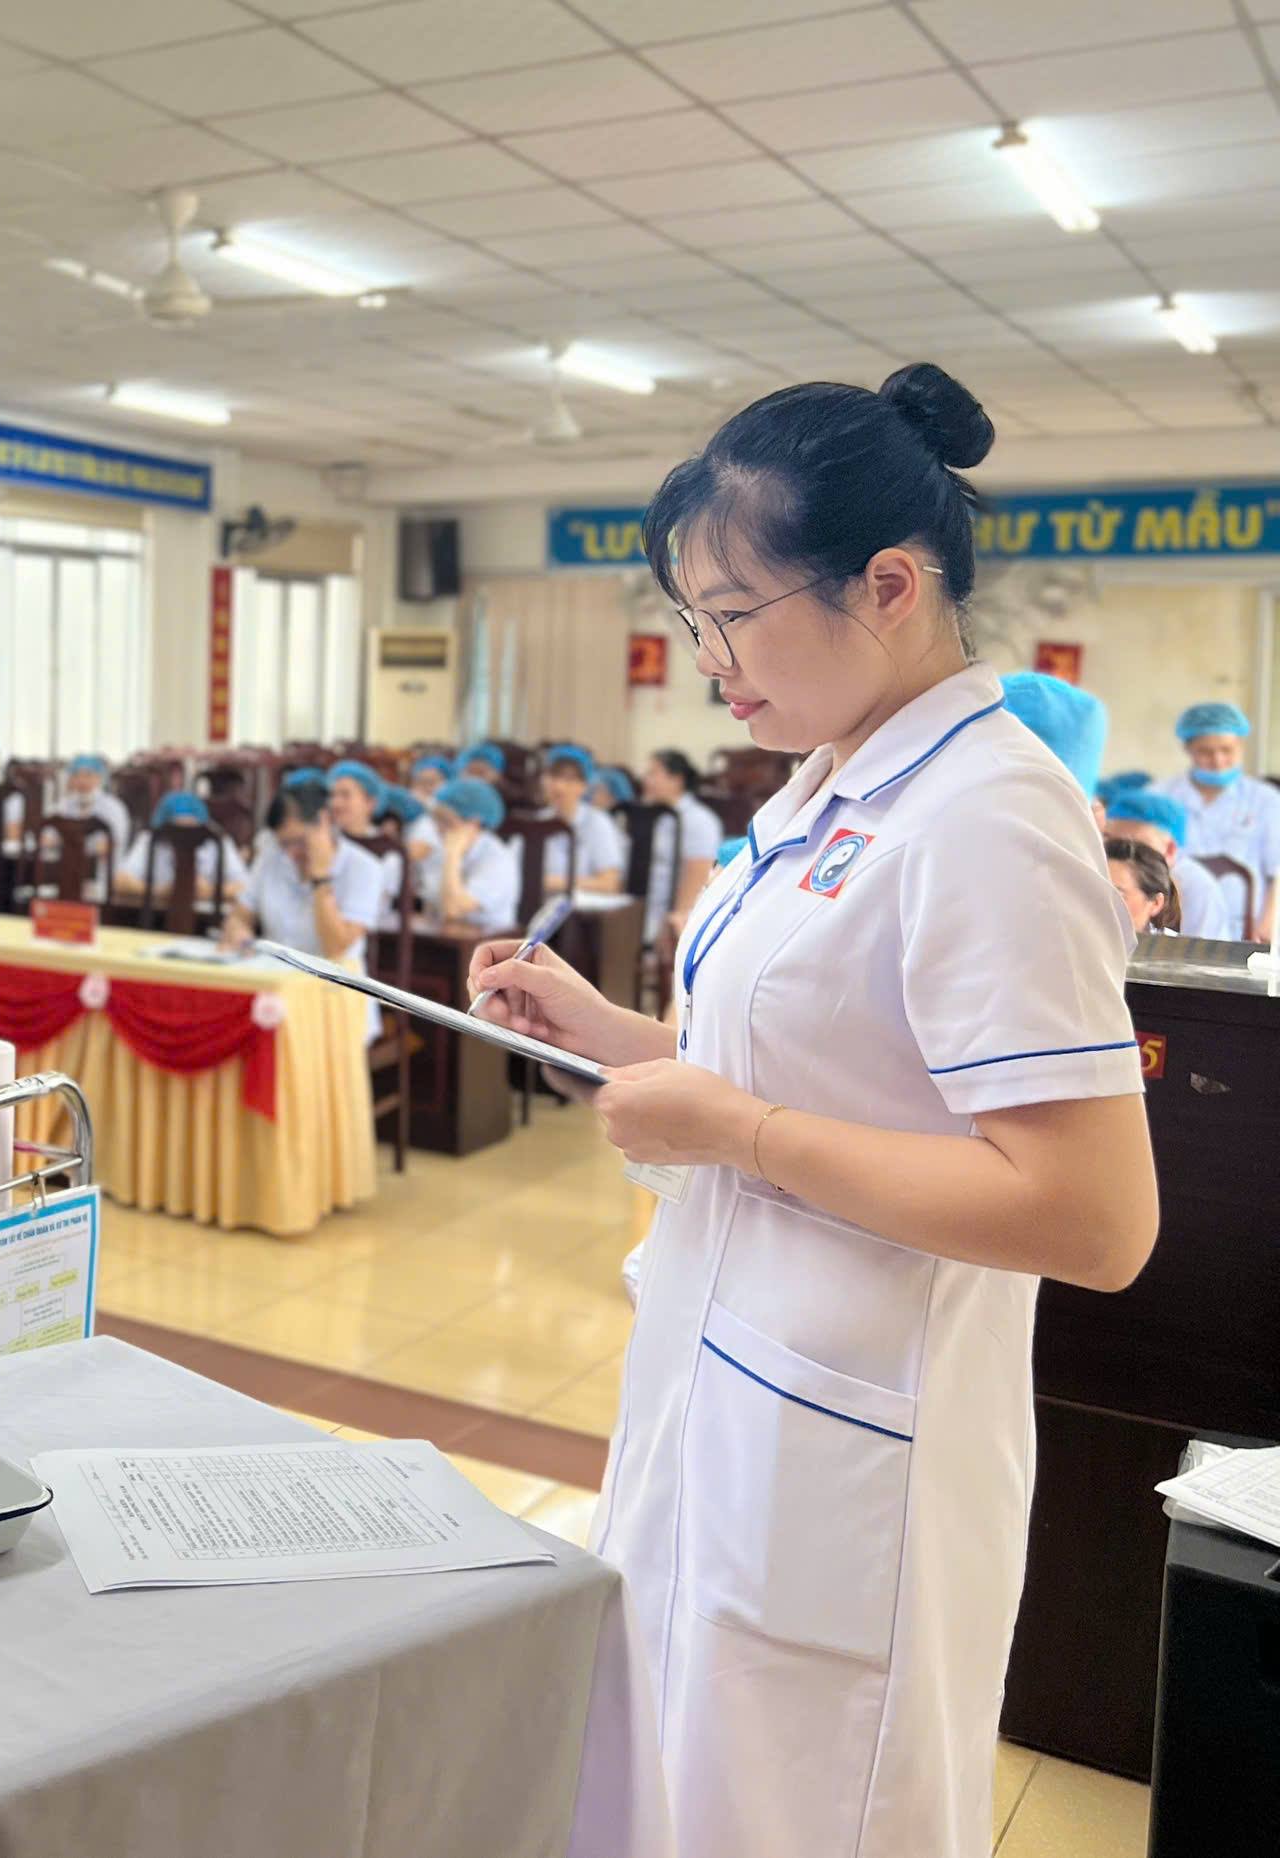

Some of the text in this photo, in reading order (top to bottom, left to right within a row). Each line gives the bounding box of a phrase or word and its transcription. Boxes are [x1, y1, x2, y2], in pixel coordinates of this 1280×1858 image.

[568, 521, 647, 560] "LƯ
[974, 513, 1040, 552] HƯ
[1048, 499, 1123, 552] TỪ
